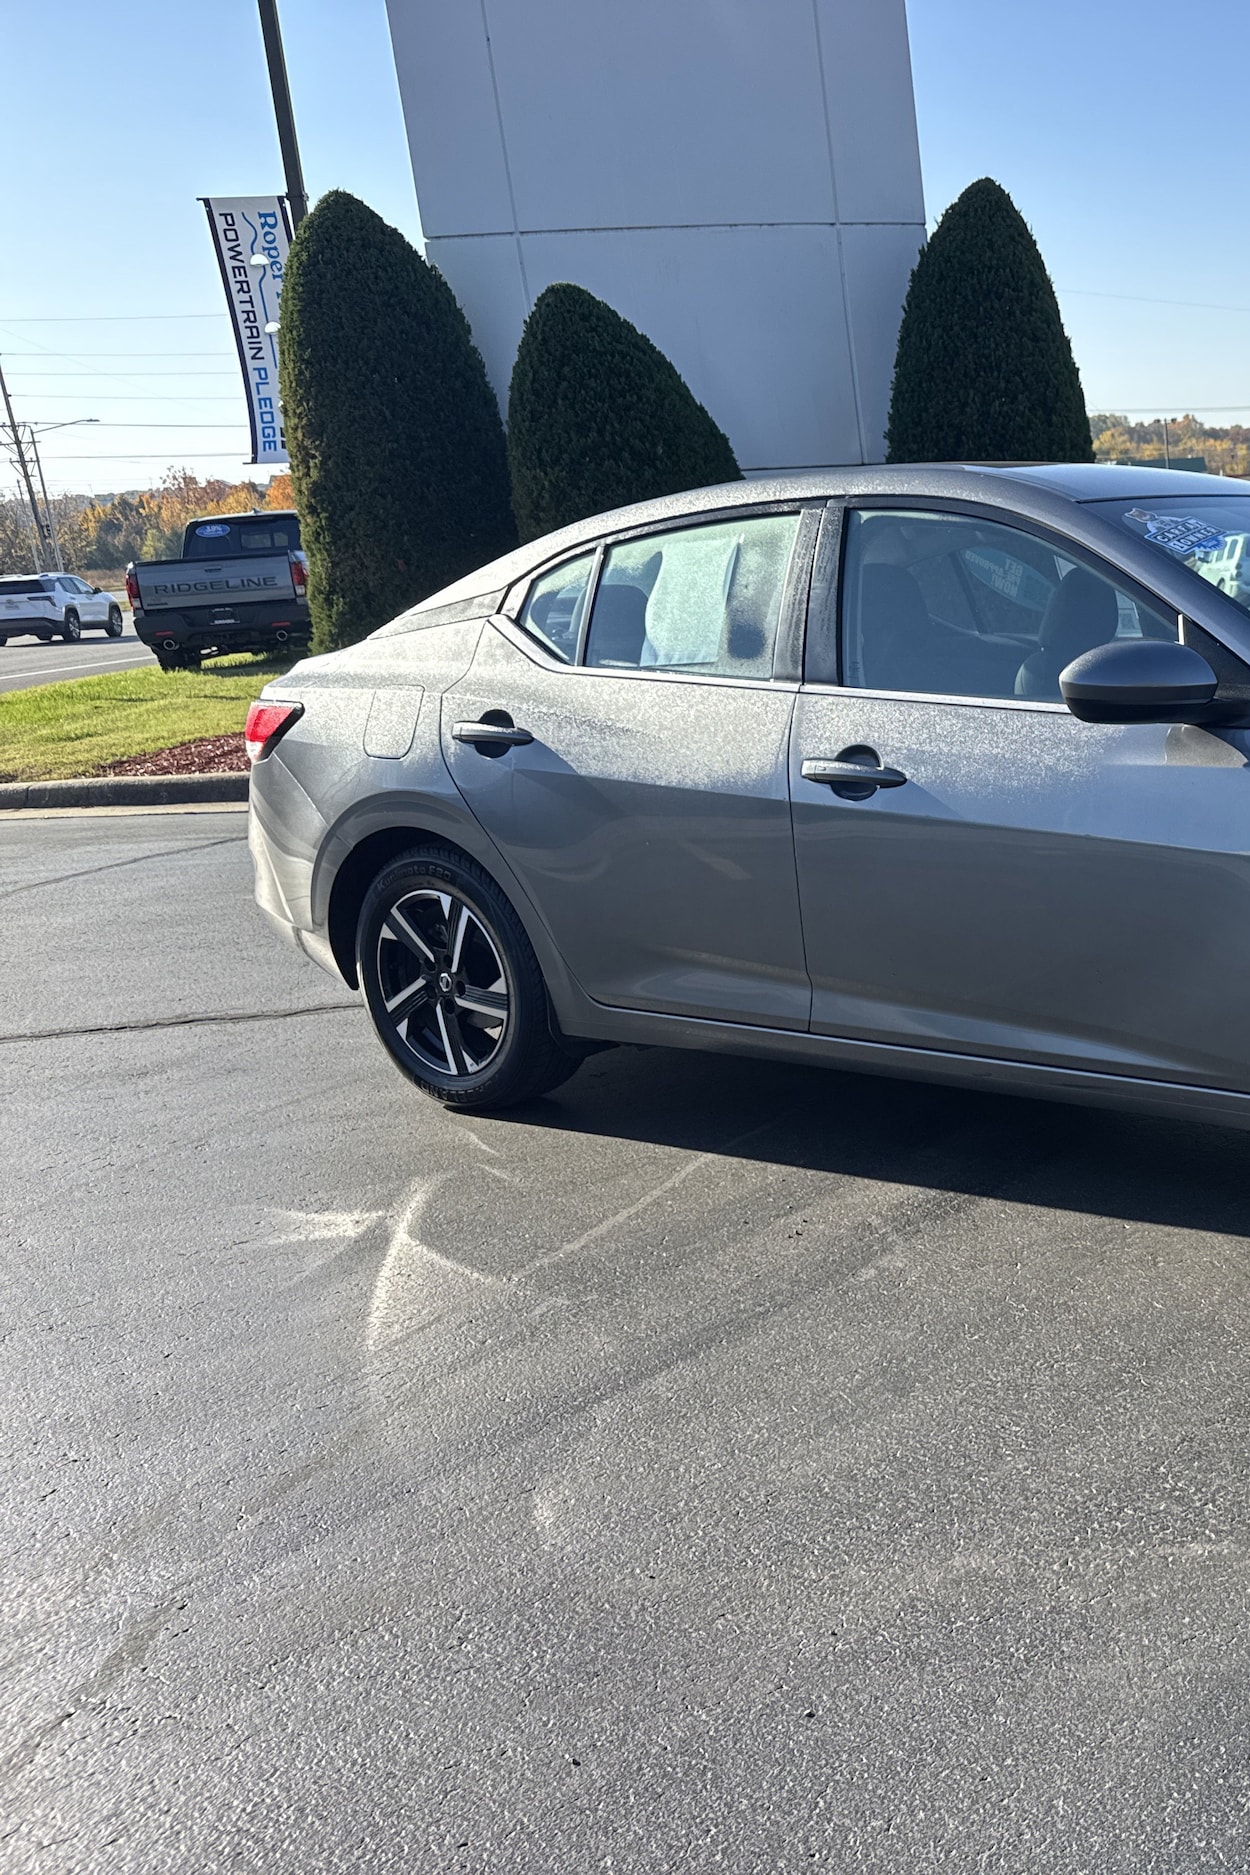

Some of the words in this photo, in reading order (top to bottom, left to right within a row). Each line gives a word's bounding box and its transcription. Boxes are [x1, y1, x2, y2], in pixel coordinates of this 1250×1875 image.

[257, 210, 283, 280] Roper
[219, 212, 265, 360] POWERTRAIN
[252, 366, 277, 452] PLEDGE
[1156, 519, 1207, 542] CARFAX
[154, 576, 278, 595] RIDGELINE
